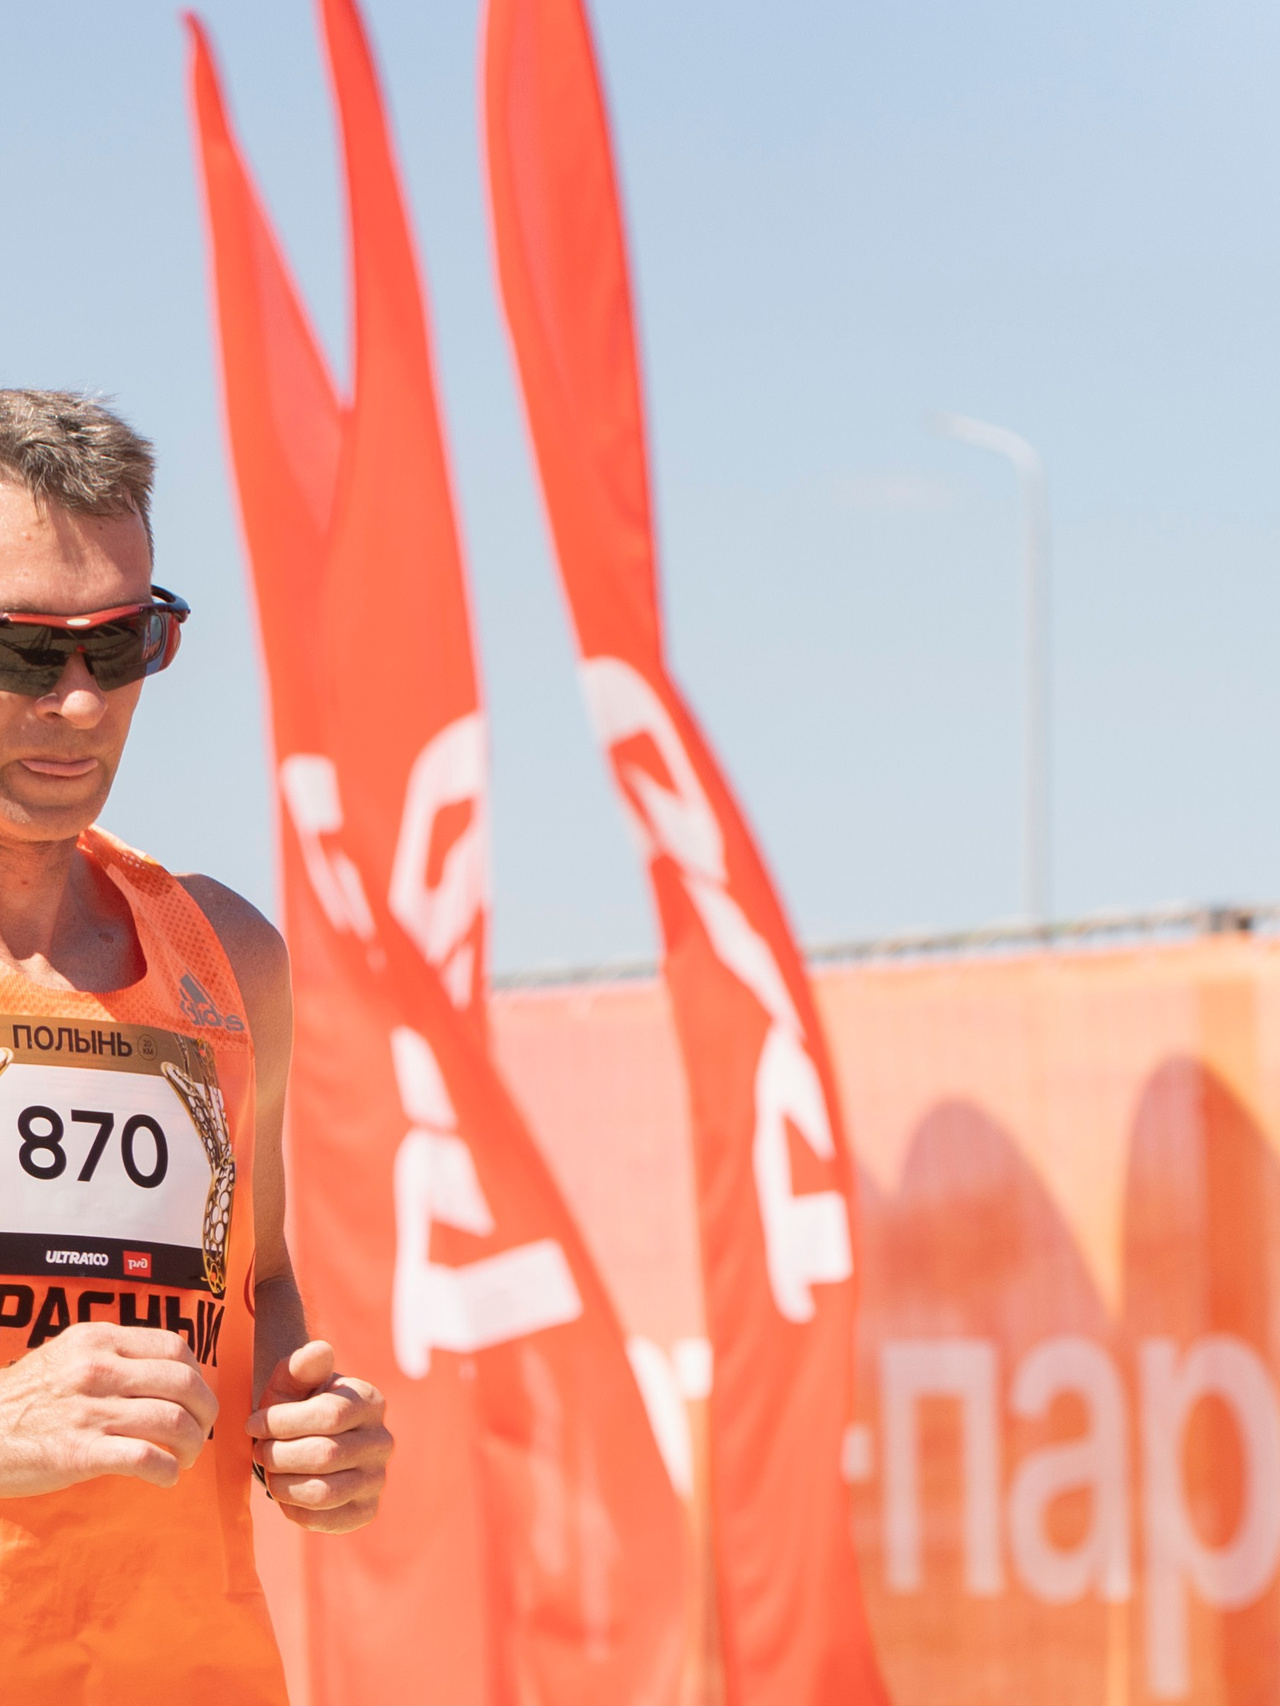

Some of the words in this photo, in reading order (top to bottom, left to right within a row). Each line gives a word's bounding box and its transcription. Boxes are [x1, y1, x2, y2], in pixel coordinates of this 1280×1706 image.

[179, 999, 245, 1032] dids
[12, 1024, 133, 1058] ПОЛЫНЬ
[17, 1105, 169, 1189] 870
[45, 1250, 109, 1267] ULTRA100
